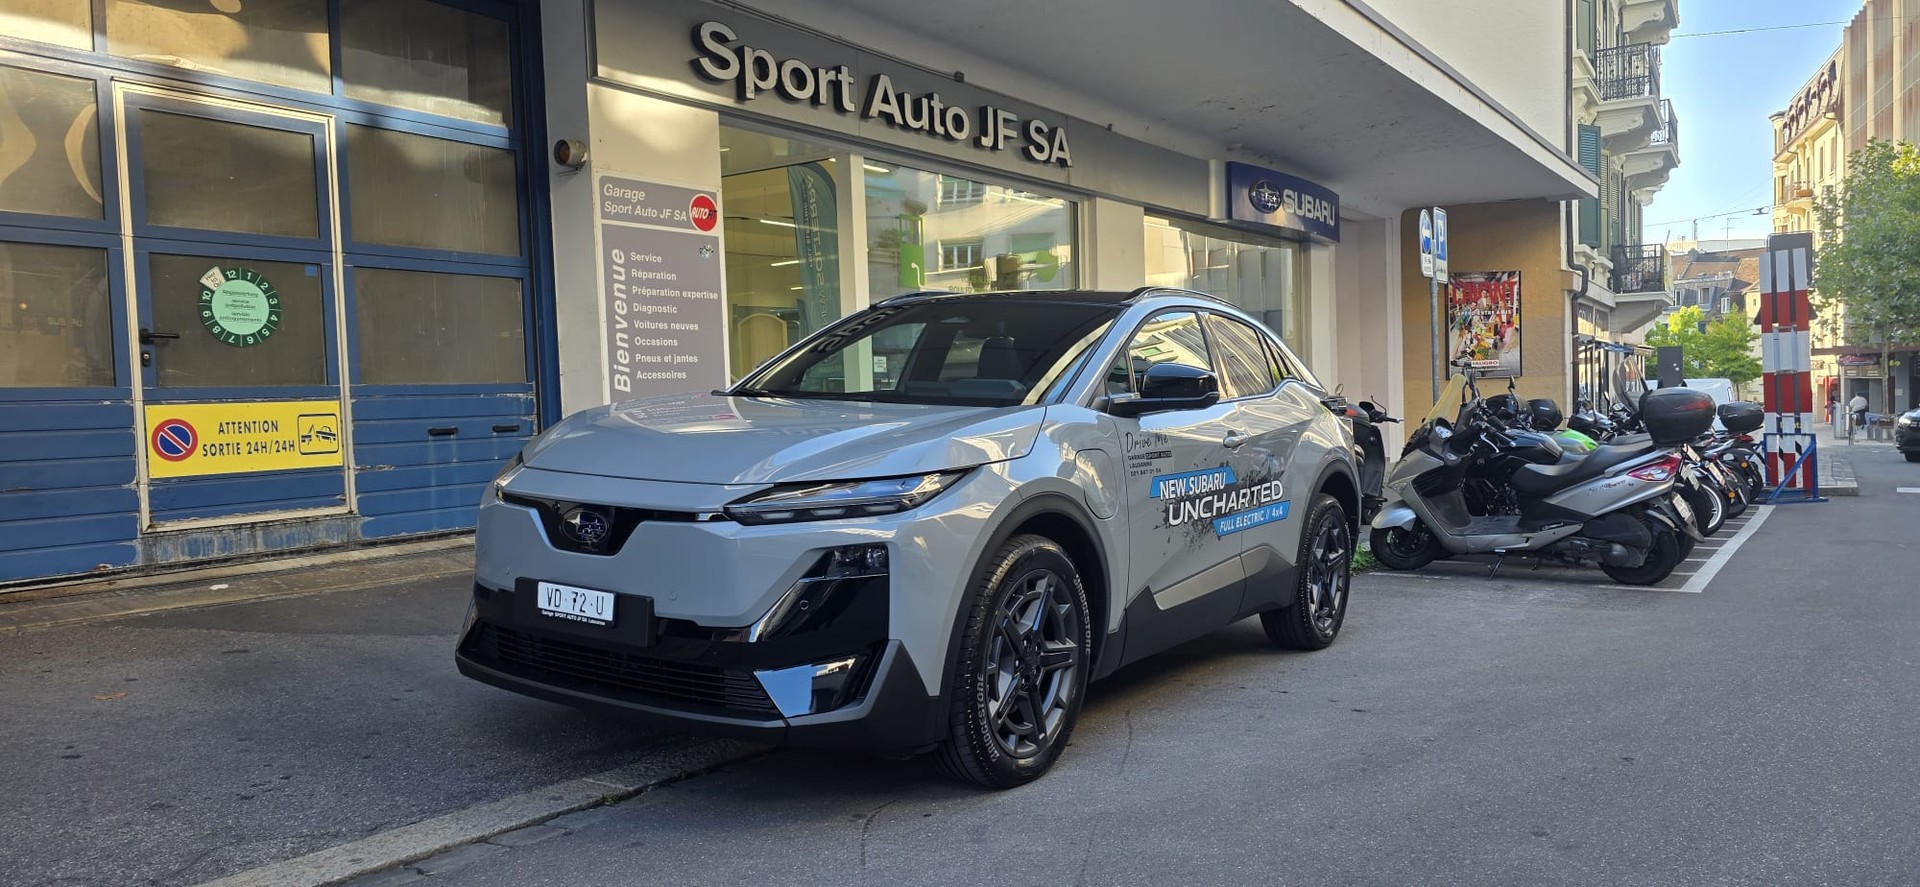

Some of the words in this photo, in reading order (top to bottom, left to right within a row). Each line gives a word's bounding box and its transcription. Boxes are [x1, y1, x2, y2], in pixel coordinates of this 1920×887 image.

[696, 20, 856, 112] Sport
[866, 73, 970, 141] Auto
[978, 104, 1018, 151] JF
[1025, 118, 1074, 168] SA
[604, 184, 646, 202] Garage
[604, 202, 632, 214] Sport
[635, 207, 658, 218] Auto
[660, 209, 672, 219] JF
[674, 210, 687, 221] SA
[1283, 188, 1335, 227] SUBARU
[631, 252, 662, 263] Service
[226, 270, 237, 278] 12
[247, 272, 252, 280] 1
[632, 269, 676, 281] Réparation
[260, 282, 269, 290] 2
[202, 291, 212, 300] 10
[632, 286, 680, 298] Préparation
[682, 291, 718, 300] expertise
[633, 303, 678, 314] Diagnostic
[612, 249, 631, 392] Bienvenue
[634, 320, 668, 330] Voitures
[671, 322, 699, 330] neuves
[212, 326, 221, 334] 8
[229, 335, 235, 343] 7
[247, 336, 254, 344] 6
[635, 337, 678, 346] Occasions
[636, 354, 662, 363] Pneus
[664, 354, 672, 363] et
[674, 355, 698, 364] jantes
[637, 371, 687, 379] Accessoires
[218, 420, 279, 435] ATTENTION
[203, 442, 241, 457] SORTIE
[246, 440, 295, 455] 24H/24H
[1125, 432, 1152, 453] Drive
[1130, 461, 1152, 469] LAUSANNE
[1160, 478, 1187, 501] NEW
[1188, 472, 1226, 496] SUBARU
[1169, 480, 1284, 526] UNCHARTED
[1220, 520, 1234, 533] FULL
[1236, 510, 1264, 528] ELECTRIC
[1271, 506, 1284, 517] 4x4
[1073, 575, 1092, 655] BRIDGESTONE
[977, 672, 1001, 762] BRIDGESTONE
